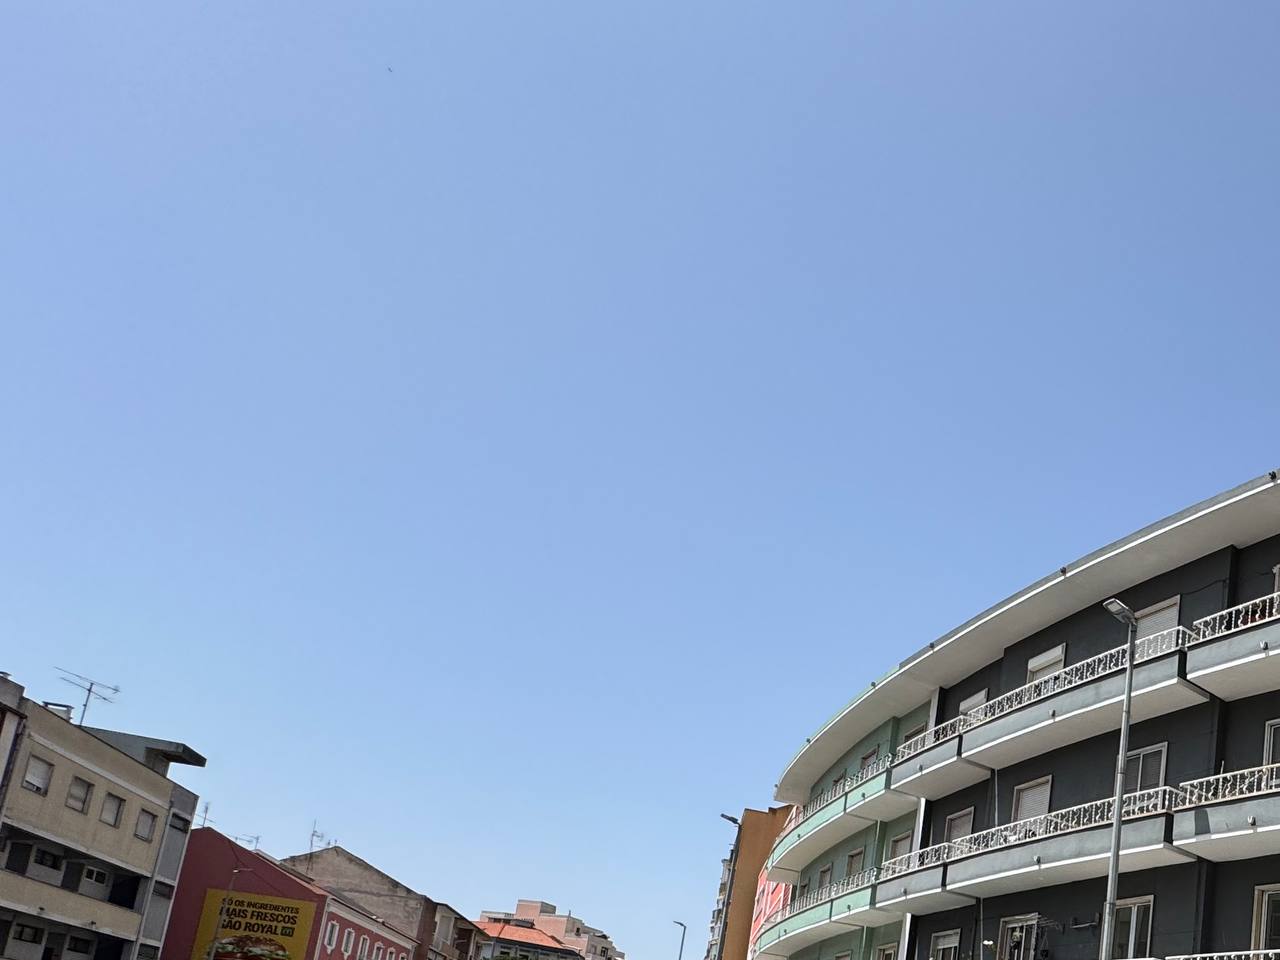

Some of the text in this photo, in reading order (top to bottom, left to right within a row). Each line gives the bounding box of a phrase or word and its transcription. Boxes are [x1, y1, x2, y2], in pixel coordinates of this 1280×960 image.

[247, 901, 299, 914] INGREDIENTES
[250, 910, 298, 925] FRESCOS
[243, 921, 279, 936] ROYAL
